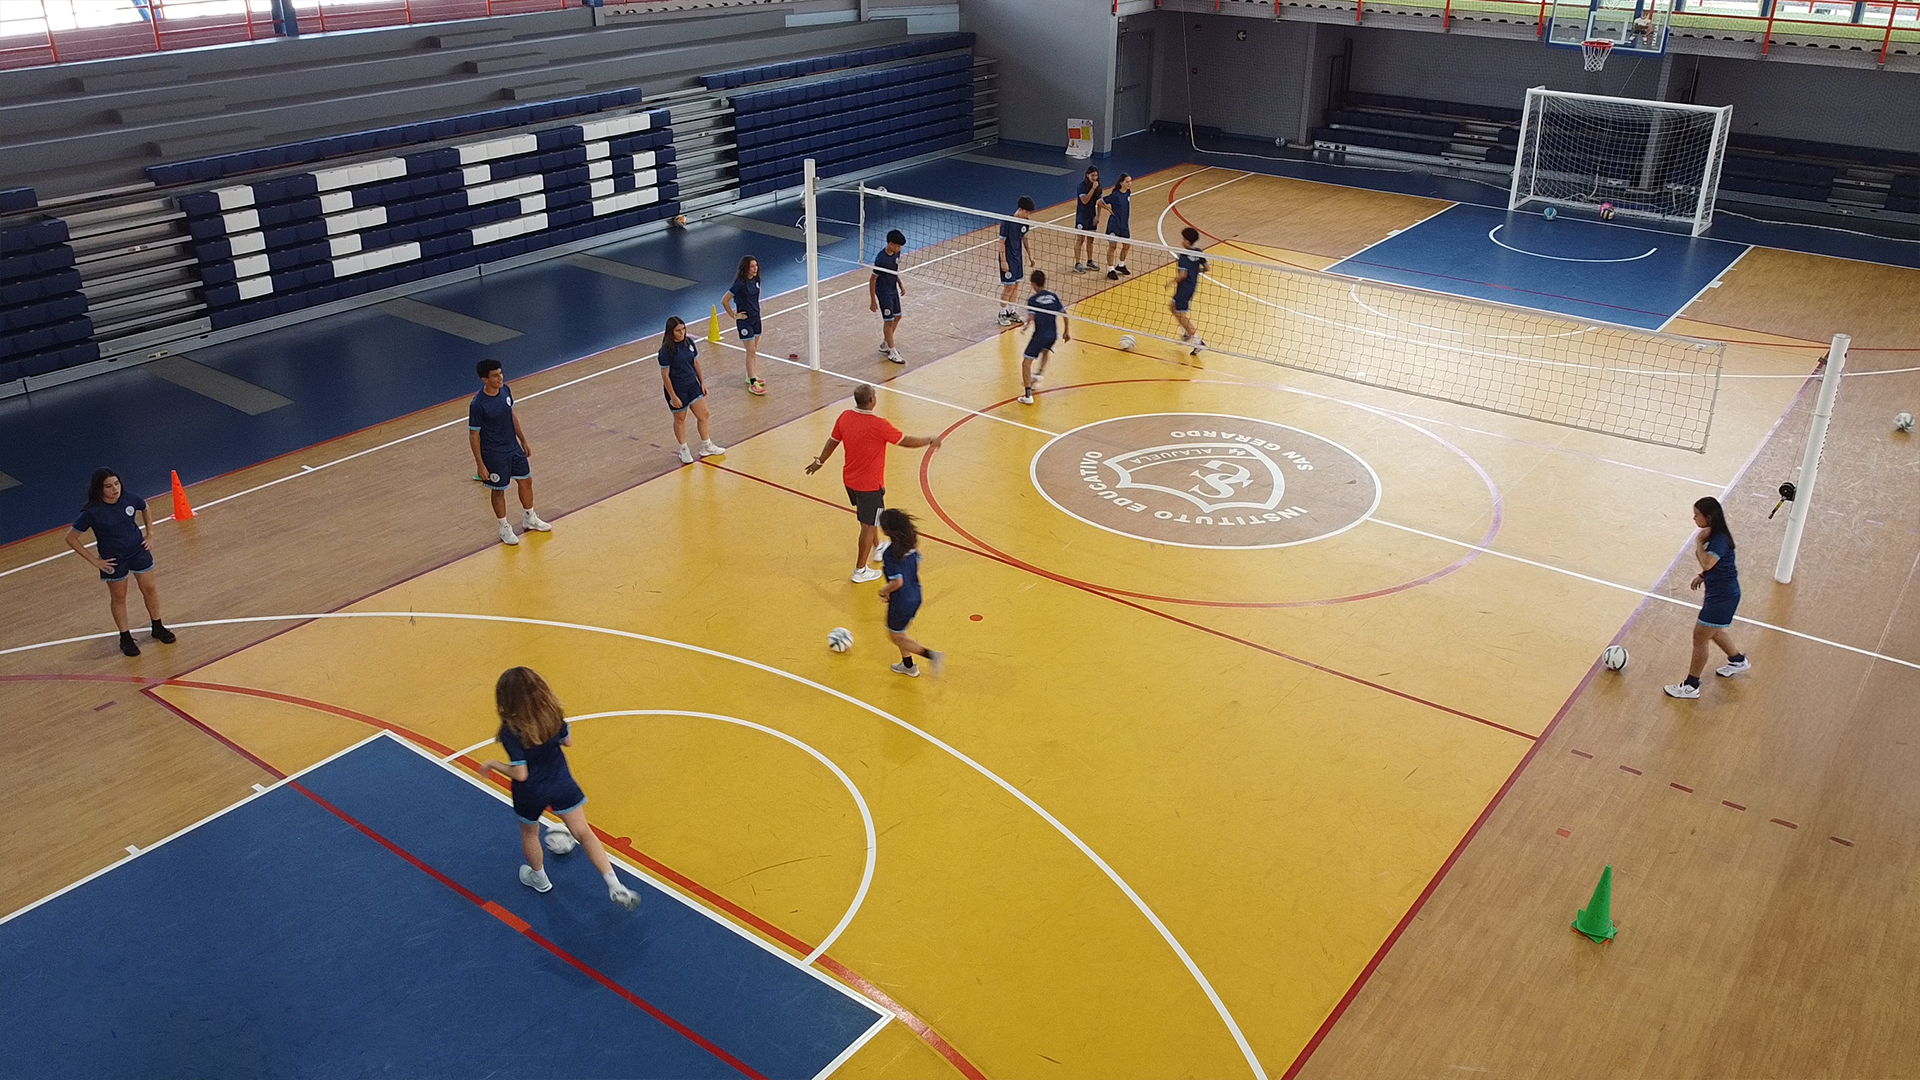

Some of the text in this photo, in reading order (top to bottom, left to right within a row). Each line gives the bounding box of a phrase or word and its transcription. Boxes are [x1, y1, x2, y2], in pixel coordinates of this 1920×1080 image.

[213, 112, 660, 300] IESG
[1129, 448, 1212, 464] ALAJUELA
[1170, 430, 1313, 471] SAN GERARDO
[1080, 451, 1308, 526] INSTITUTO EDUCATIVO
